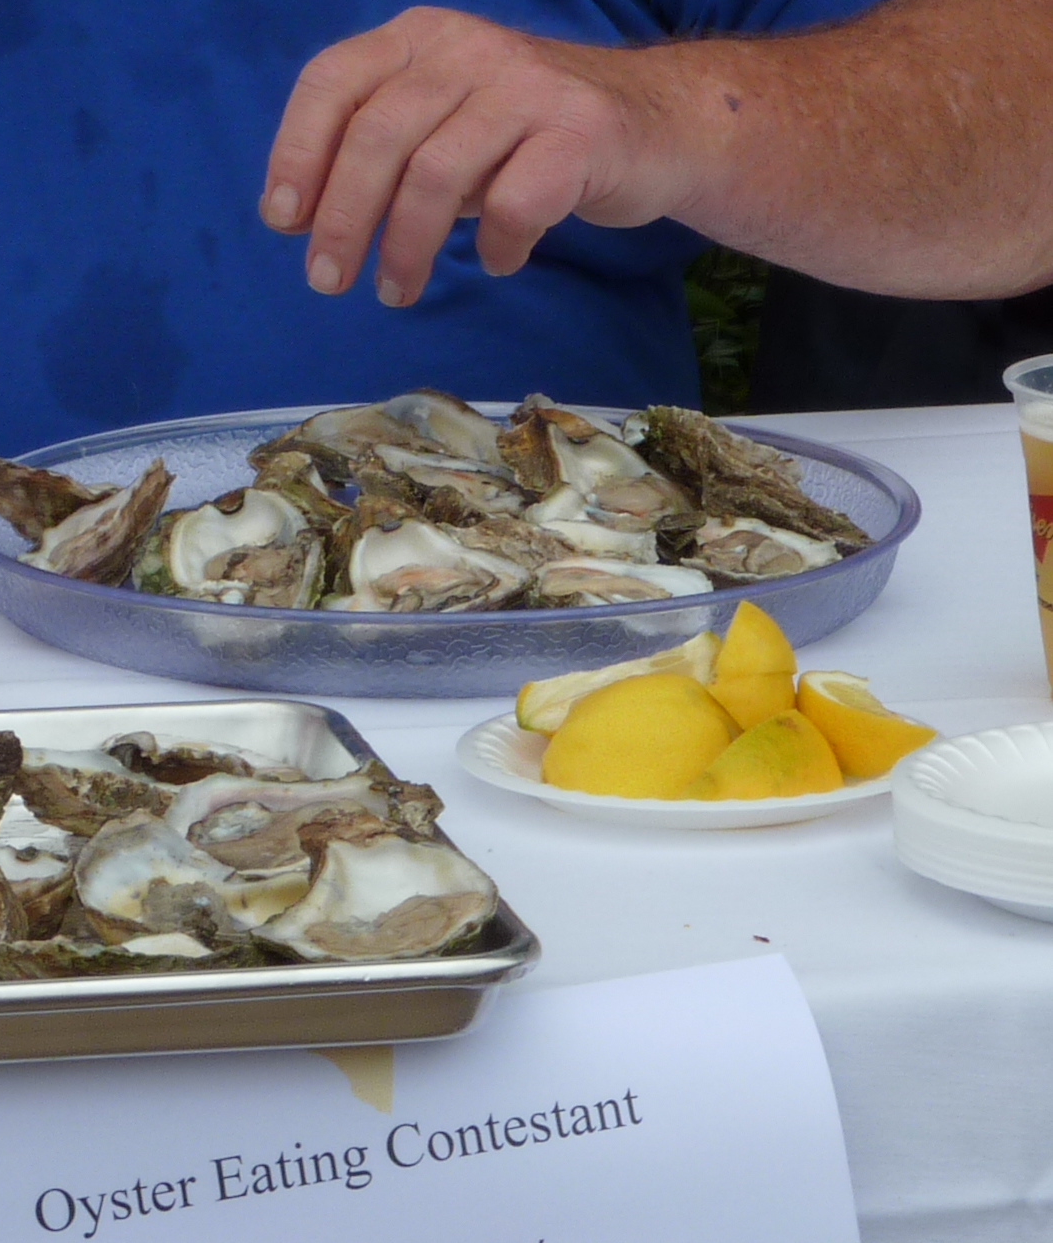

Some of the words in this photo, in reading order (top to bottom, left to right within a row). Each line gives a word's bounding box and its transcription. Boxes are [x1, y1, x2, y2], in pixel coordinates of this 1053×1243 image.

[34, 1174, 198, 1240] Oyster
[212, 1141, 373, 1191] Eating
[385, 1087, 645, 1169] Contestant
